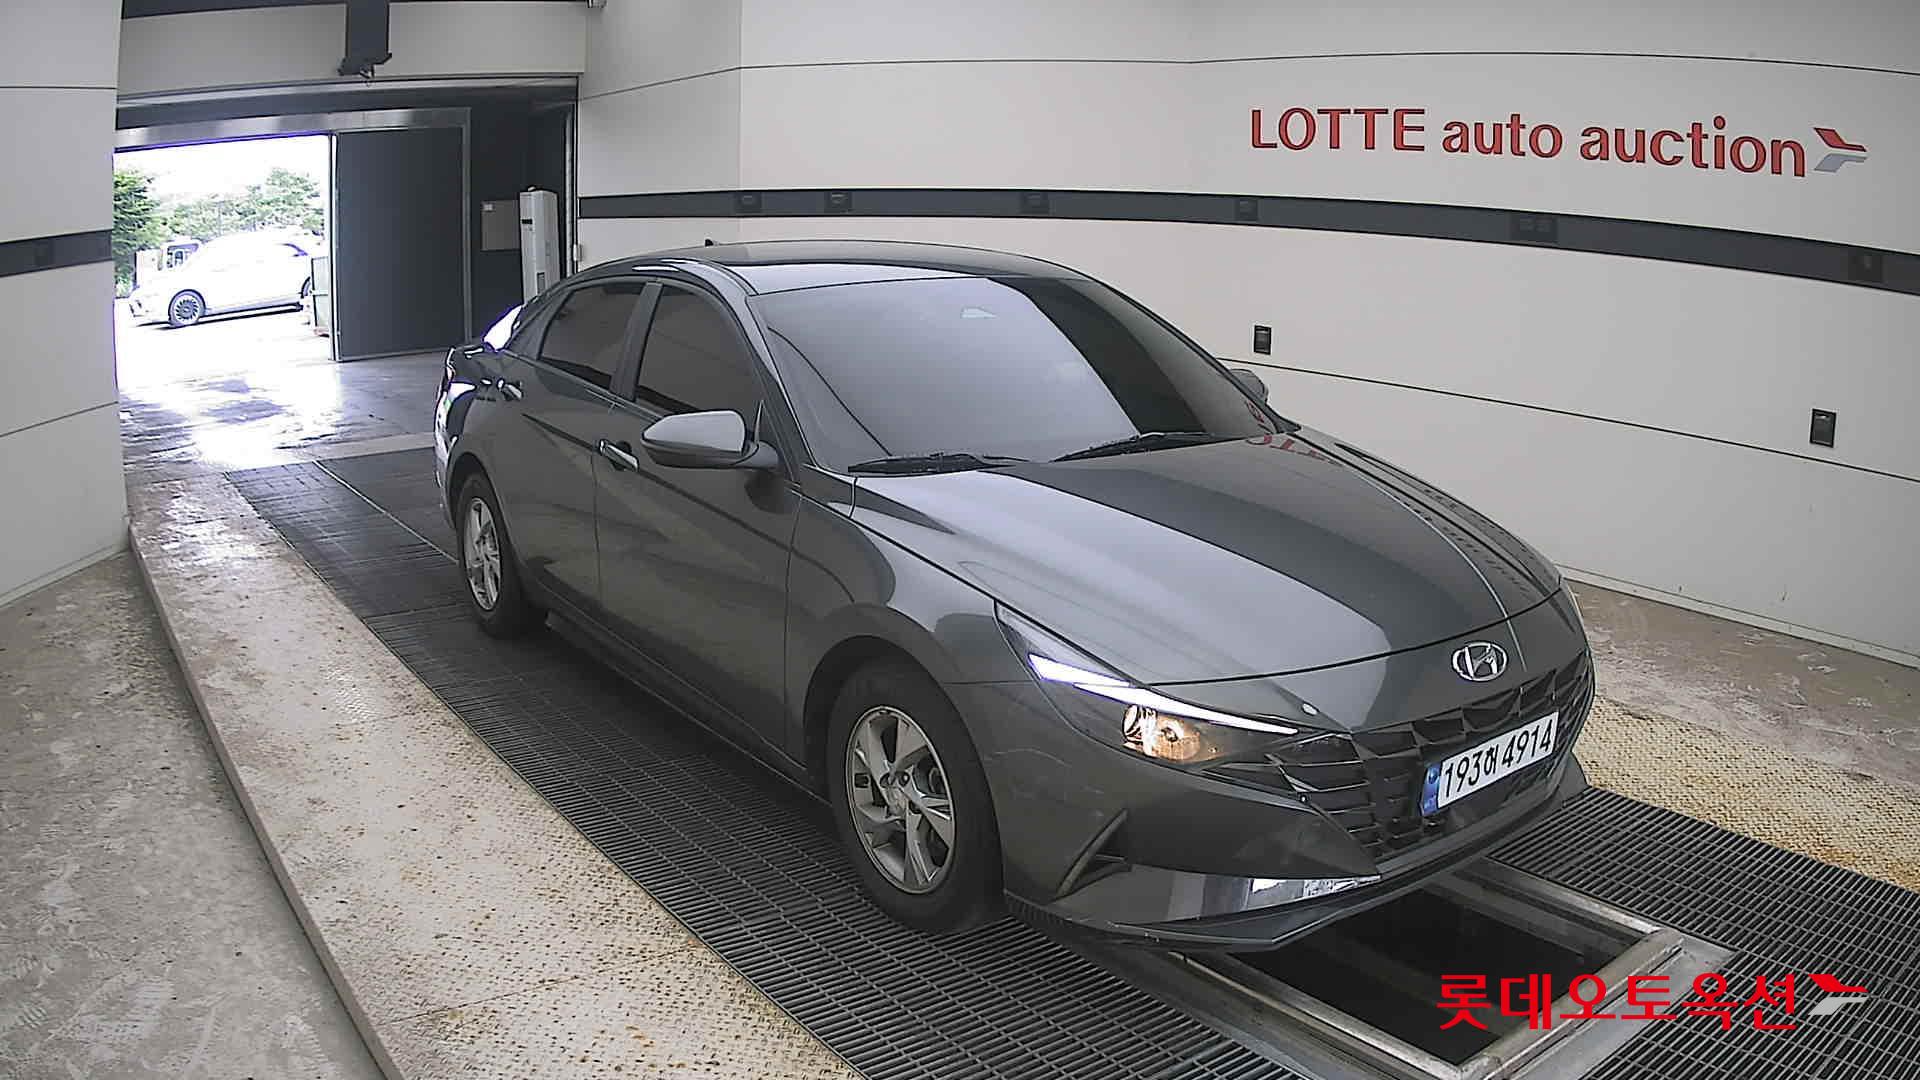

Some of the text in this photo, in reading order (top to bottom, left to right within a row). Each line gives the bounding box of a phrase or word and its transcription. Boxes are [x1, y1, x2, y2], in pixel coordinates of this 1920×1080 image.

[1250, 107, 1807, 178] LOTTE auto auction
[1501, 719, 1553, 769] 4914
